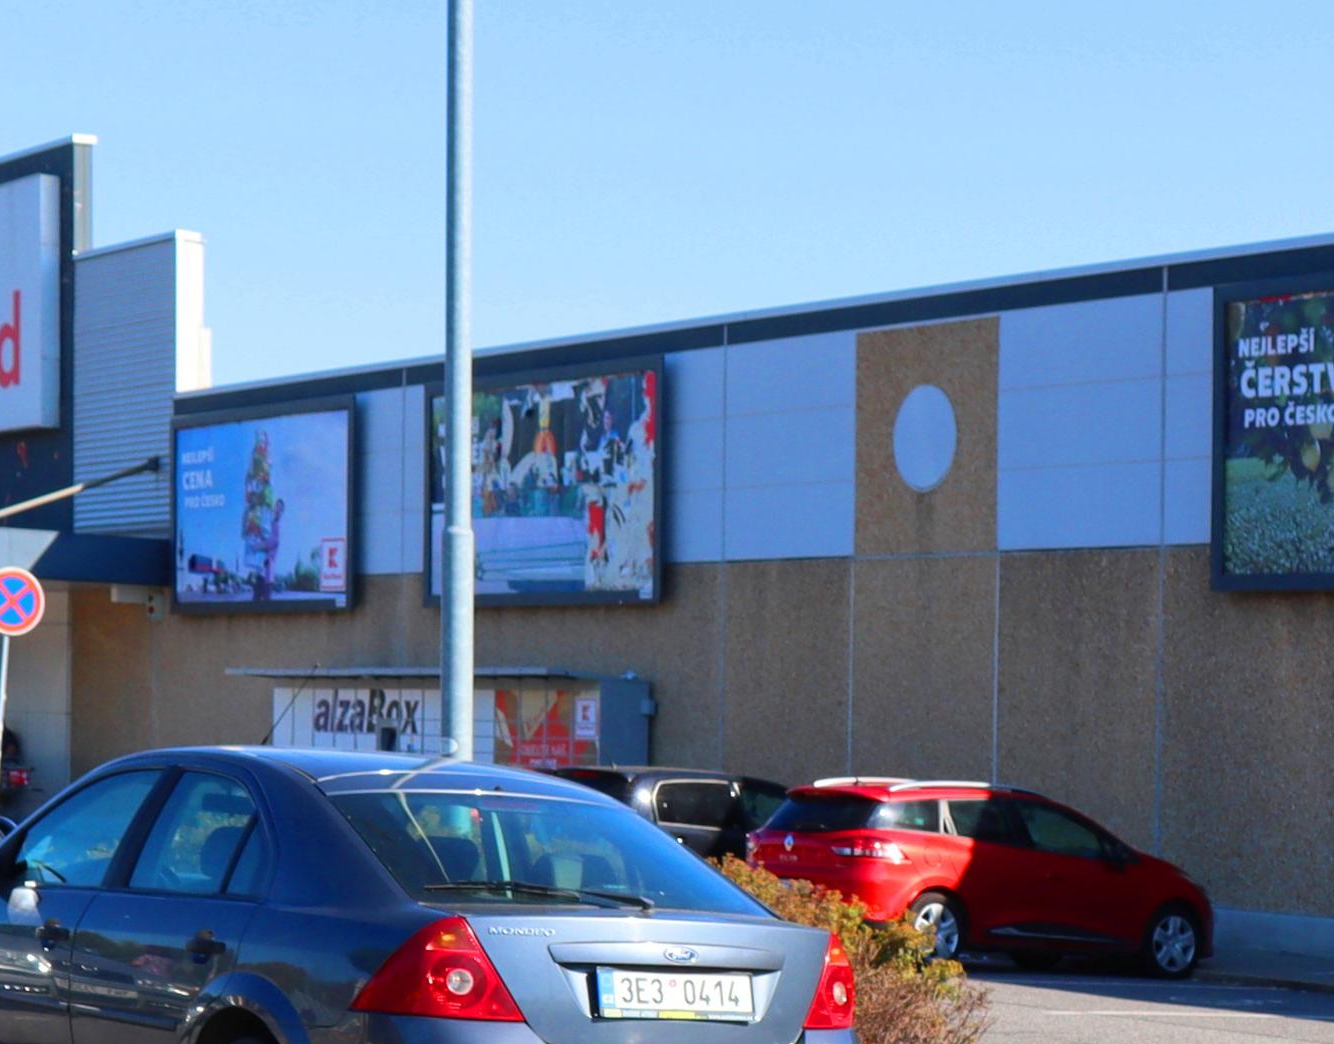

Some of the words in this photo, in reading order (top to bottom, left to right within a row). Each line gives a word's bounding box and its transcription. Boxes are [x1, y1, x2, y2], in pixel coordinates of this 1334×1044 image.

[1238, 327, 1315, 358] NEJLEPŠÍ
[1244, 407, 1281, 429] PRO
[183, 470, 214, 491] CENA
[314, 687, 419, 734] alzaBox
[488, 926, 556, 937] MONDEO
[621, 977, 665, 1005] 3E3
[683, 978, 741, 1007] 0414
